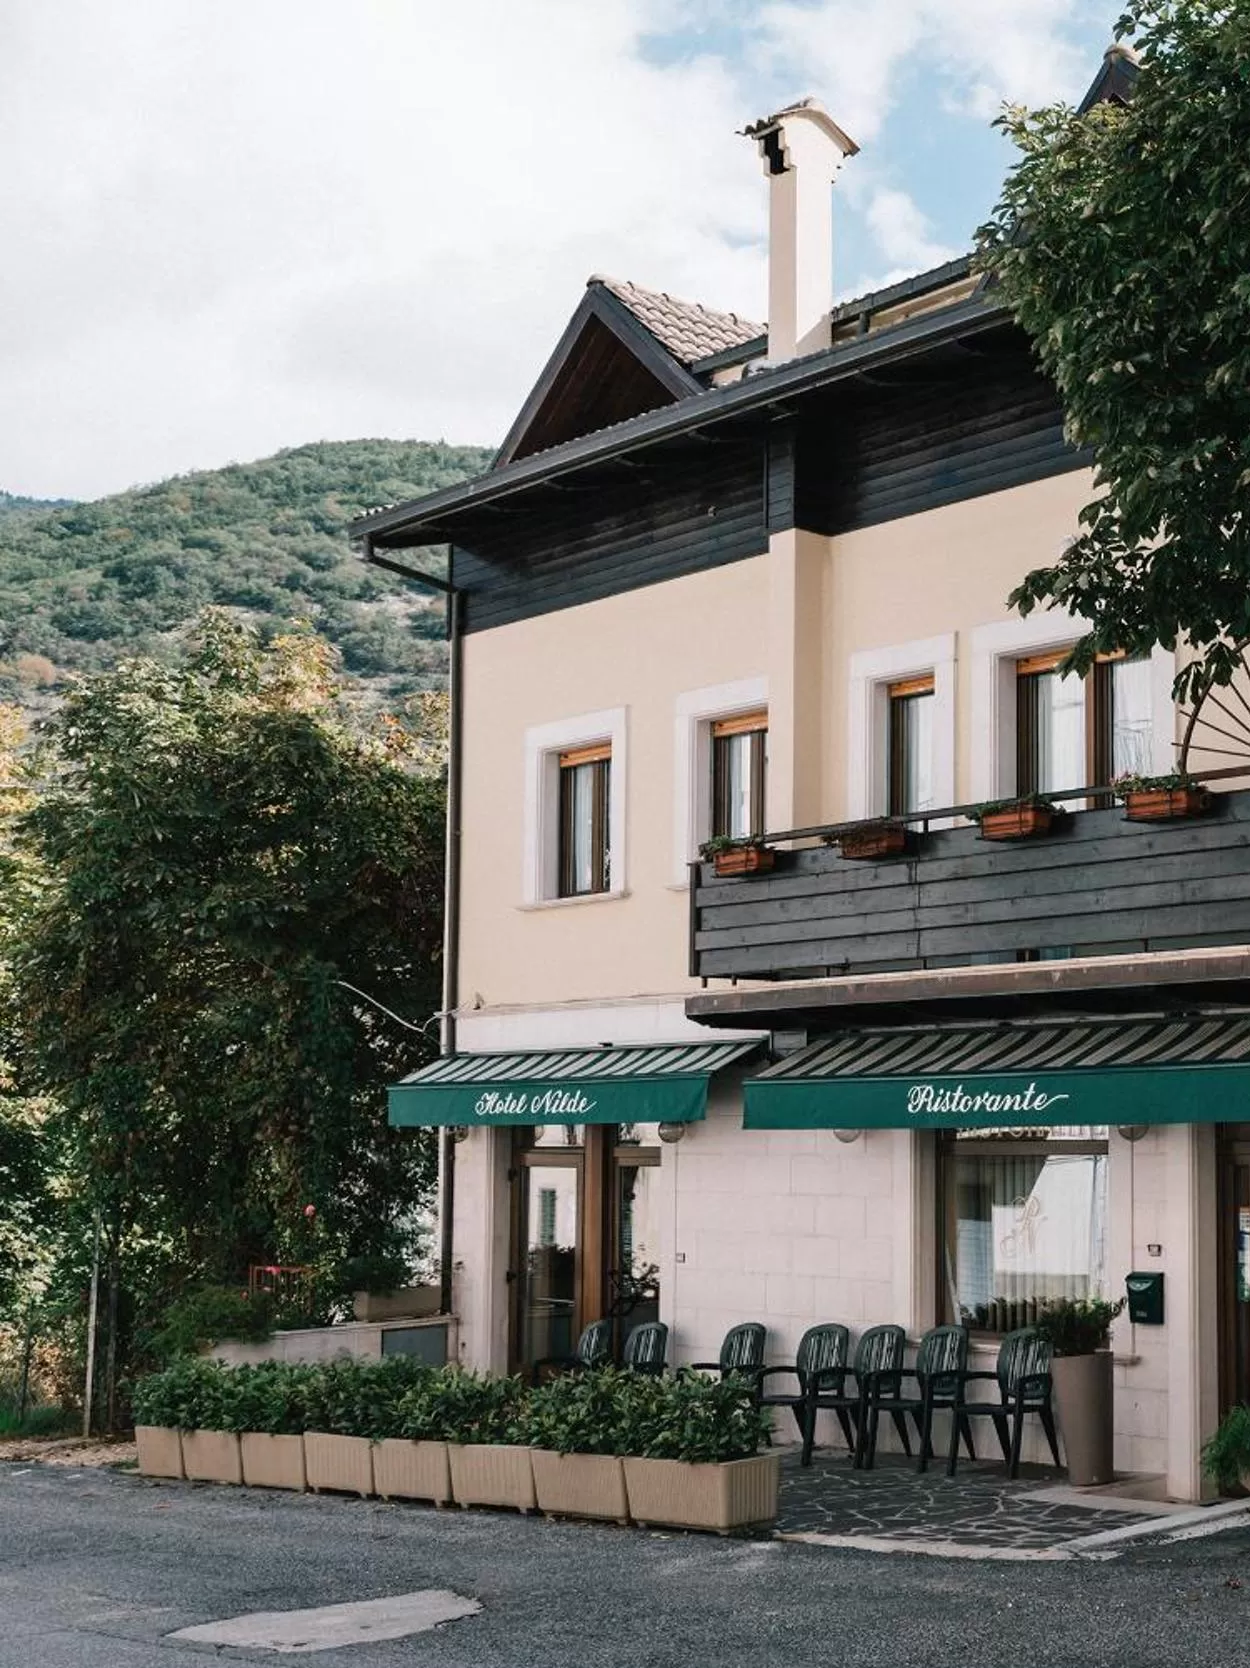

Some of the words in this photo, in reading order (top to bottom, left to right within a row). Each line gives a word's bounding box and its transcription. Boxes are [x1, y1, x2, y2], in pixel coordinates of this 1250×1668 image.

[475, 1091, 528, 1116] Hotel
[530, 1089, 598, 1115] Nilde
[907, 1082, 1069, 1113] Ristorante
